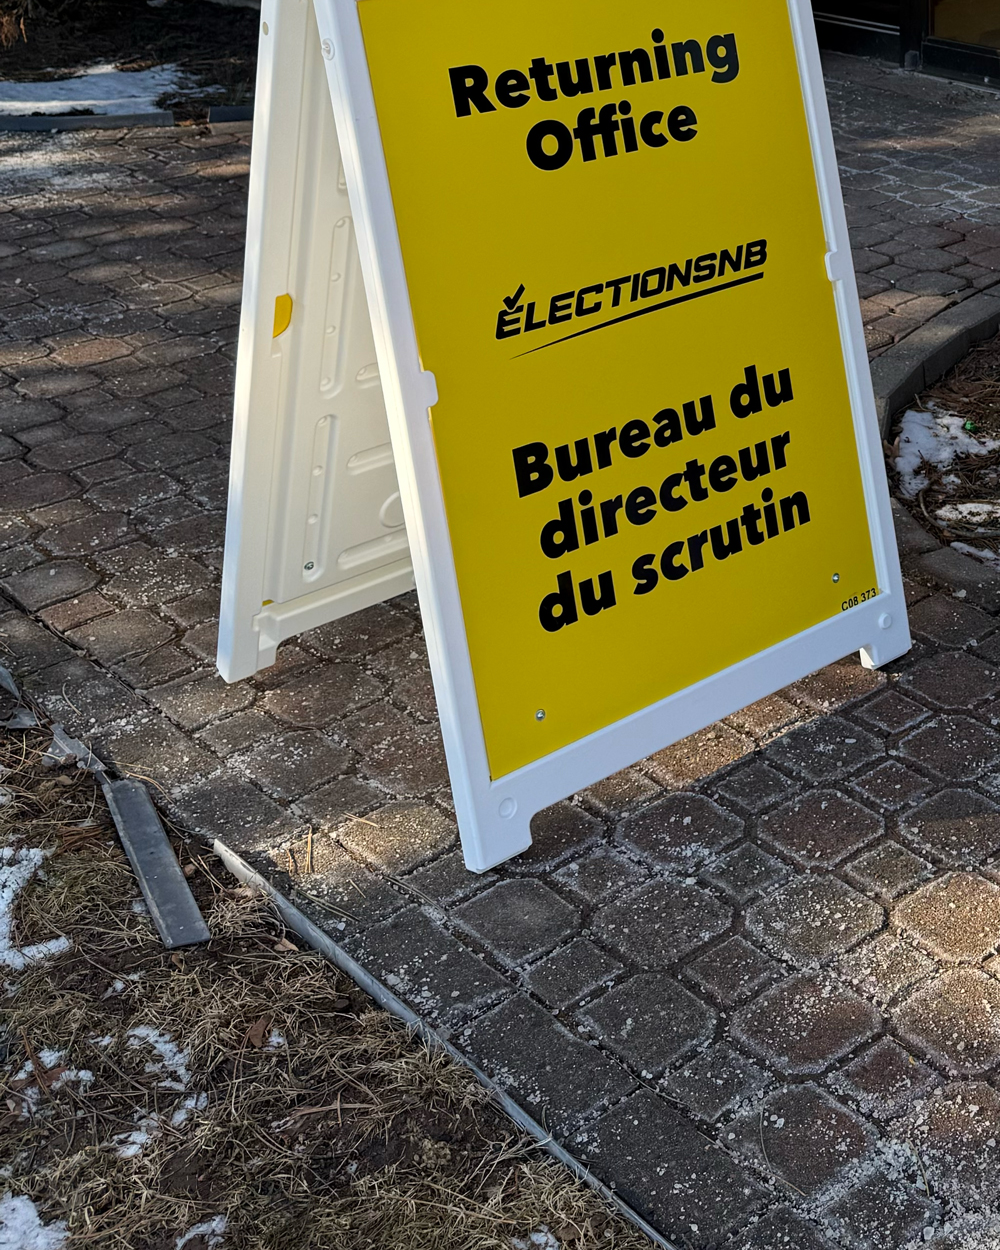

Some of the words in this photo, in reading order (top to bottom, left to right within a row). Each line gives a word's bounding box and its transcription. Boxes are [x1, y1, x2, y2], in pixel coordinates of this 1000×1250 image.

[449, 29, 740, 117] Returning
[527, 100, 697, 170] Office
[512, 395, 716, 498] Bureau
[730, 365, 794, 418] du
[540, 431, 791, 559] directeur
[539, 570, 616, 632] du
[632, 488, 811, 595] scrutin
[842, 596, 858, 611] C08
[860, 588, 876, 602] 373
